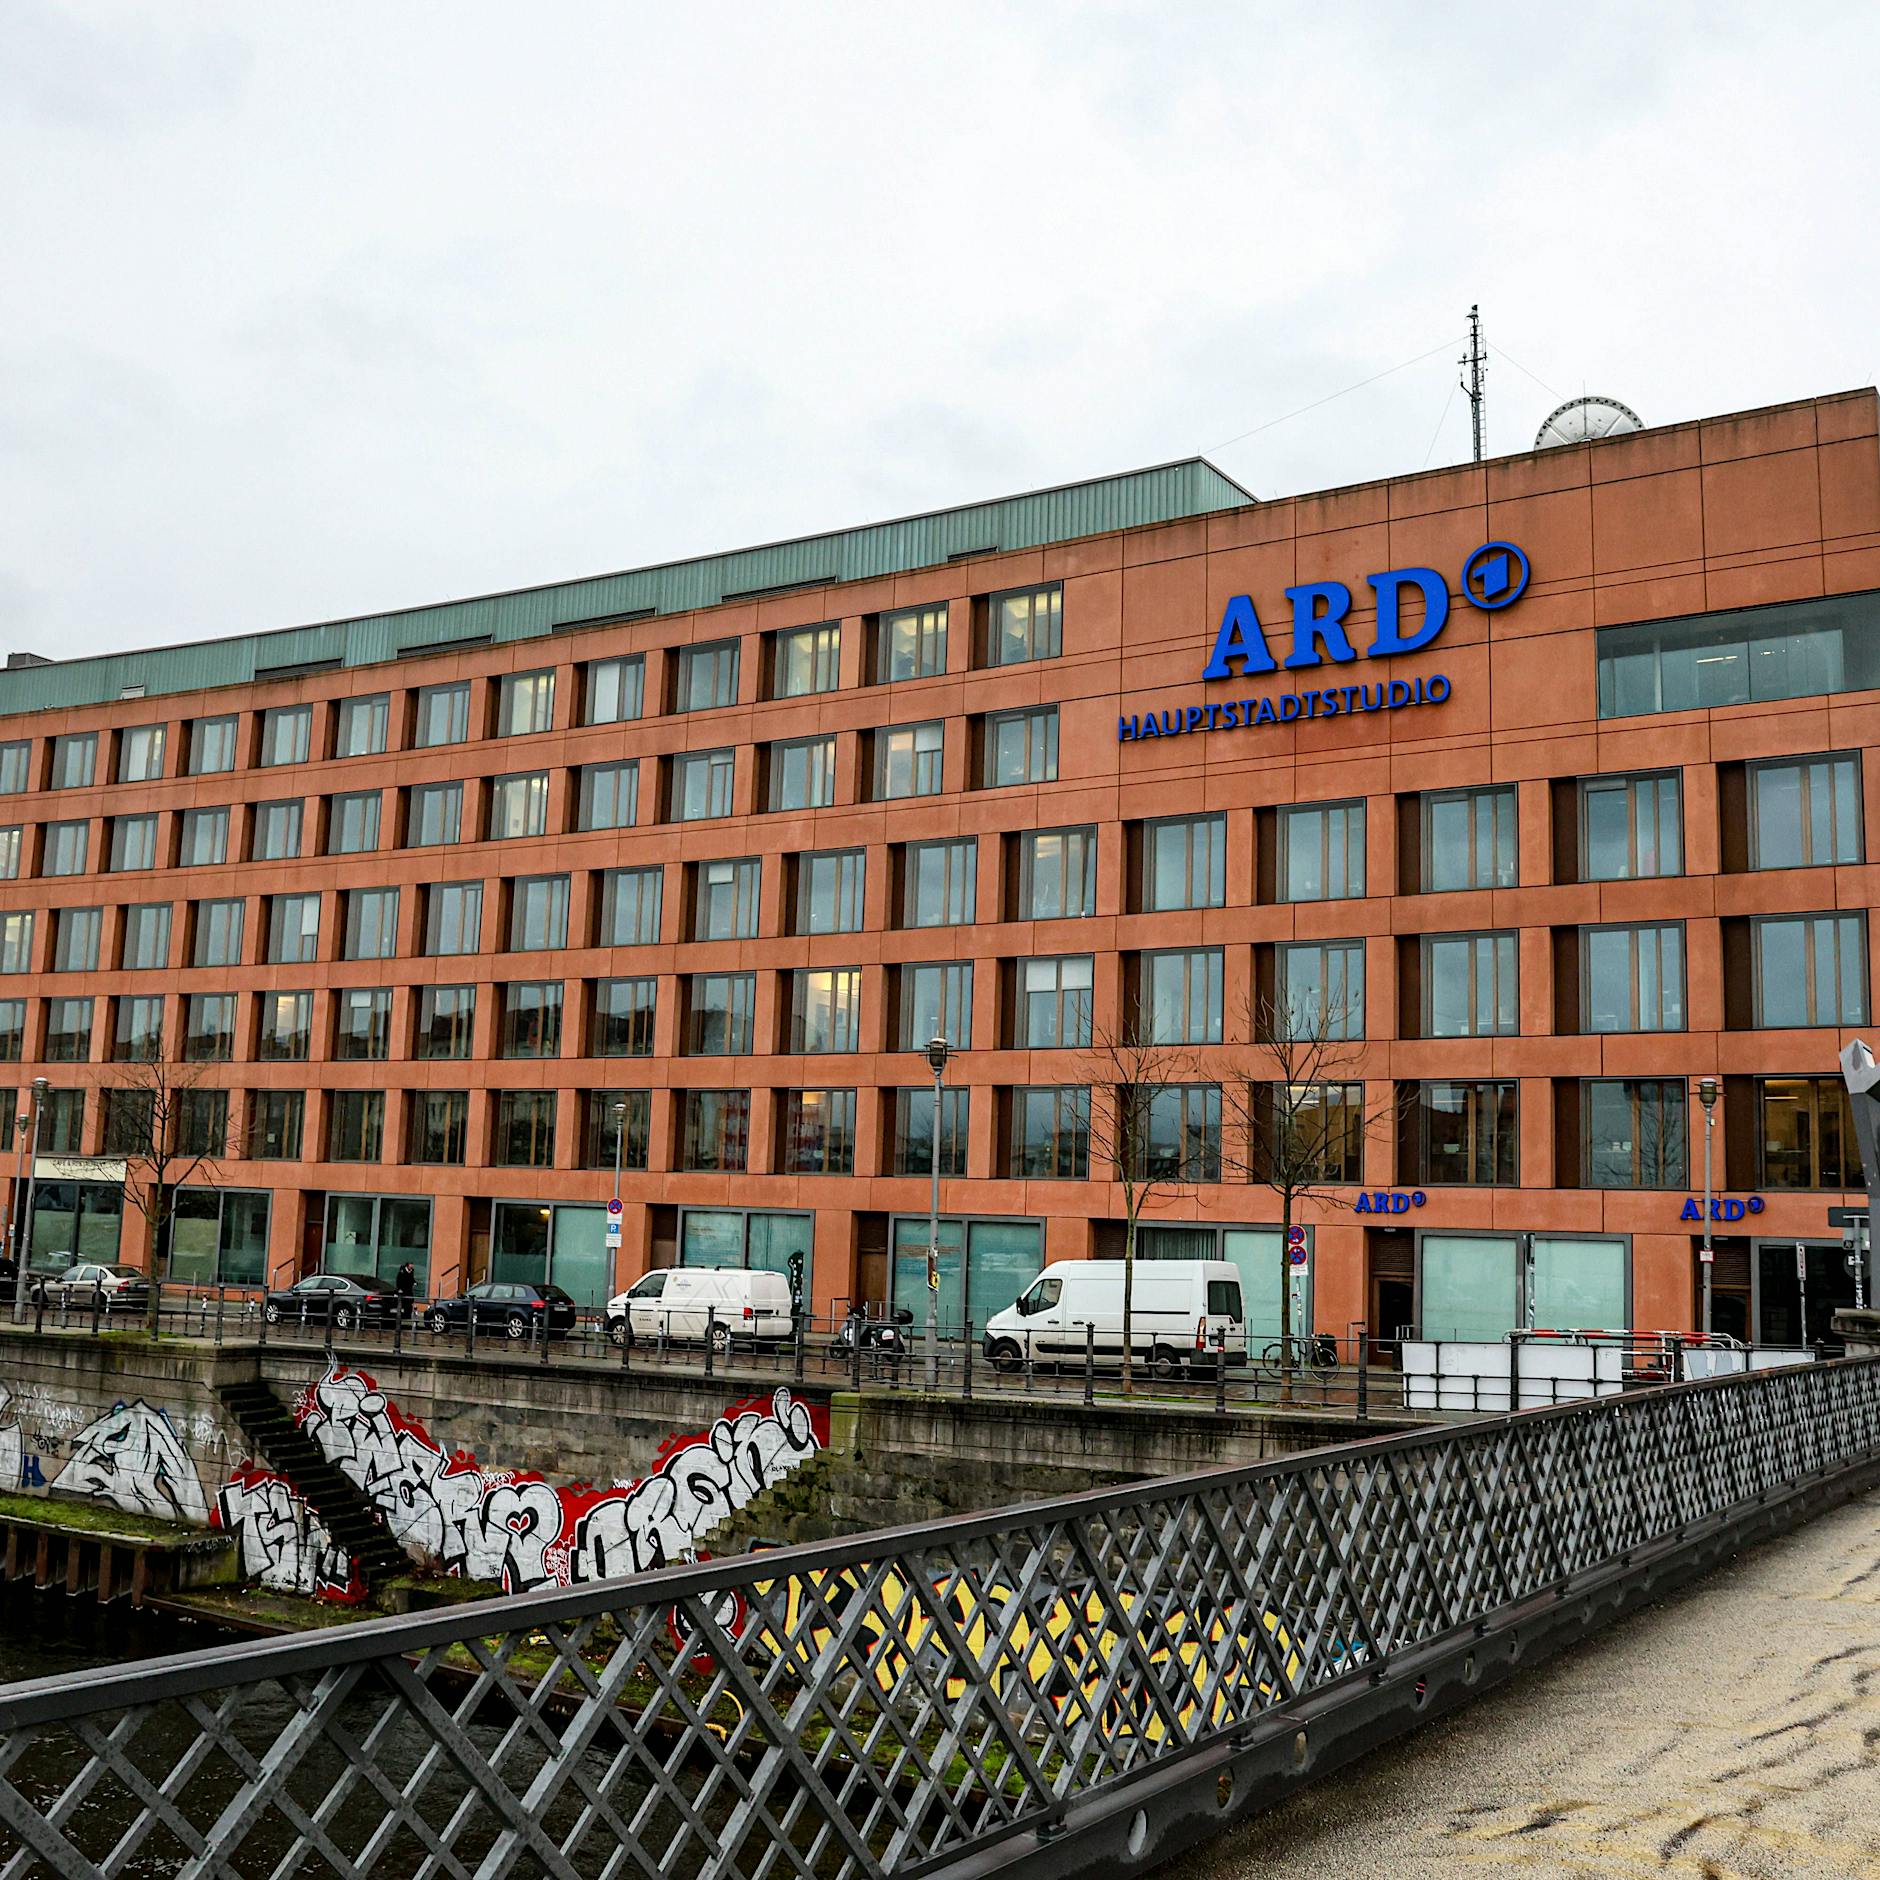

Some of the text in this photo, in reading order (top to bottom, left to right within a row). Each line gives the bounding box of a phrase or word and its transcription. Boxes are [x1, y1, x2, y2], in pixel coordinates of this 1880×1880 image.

[1202, 567, 1450, 681] ARD
[1117, 674, 1452, 742] HAUPTSTADTSTUDIO
[1354, 1192, 1410, 1213] ARD
[1680, 1198, 1746, 1221] ARD
